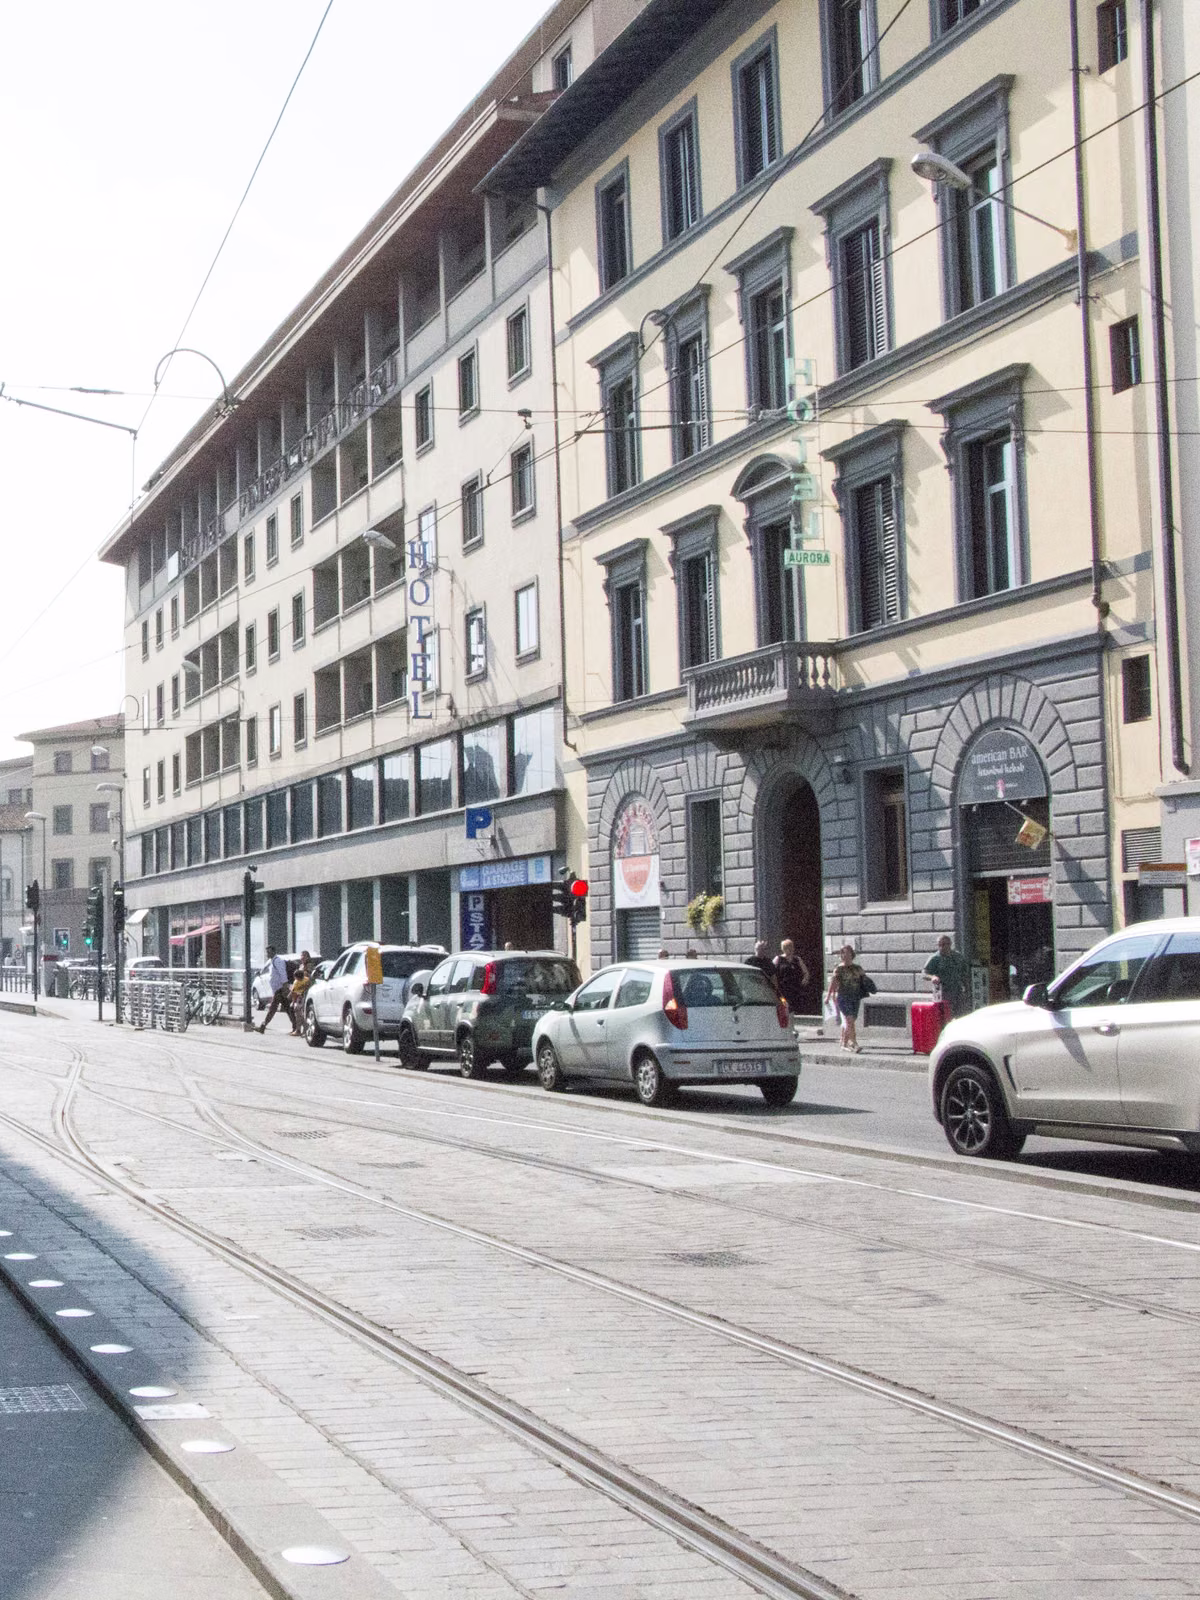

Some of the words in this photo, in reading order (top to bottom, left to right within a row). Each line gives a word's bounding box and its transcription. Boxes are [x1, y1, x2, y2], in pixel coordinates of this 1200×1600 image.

[788, 552, 830, 565] AURORA
[408, 541, 432, 719] HOTEL
[971, 749, 1008, 764] american
[1009, 745, 1028, 759] BAR
[465, 808, 493, 839] P
[482, 860, 527, 876] GARAGE
[492, 872, 527, 886] STAZIONE
